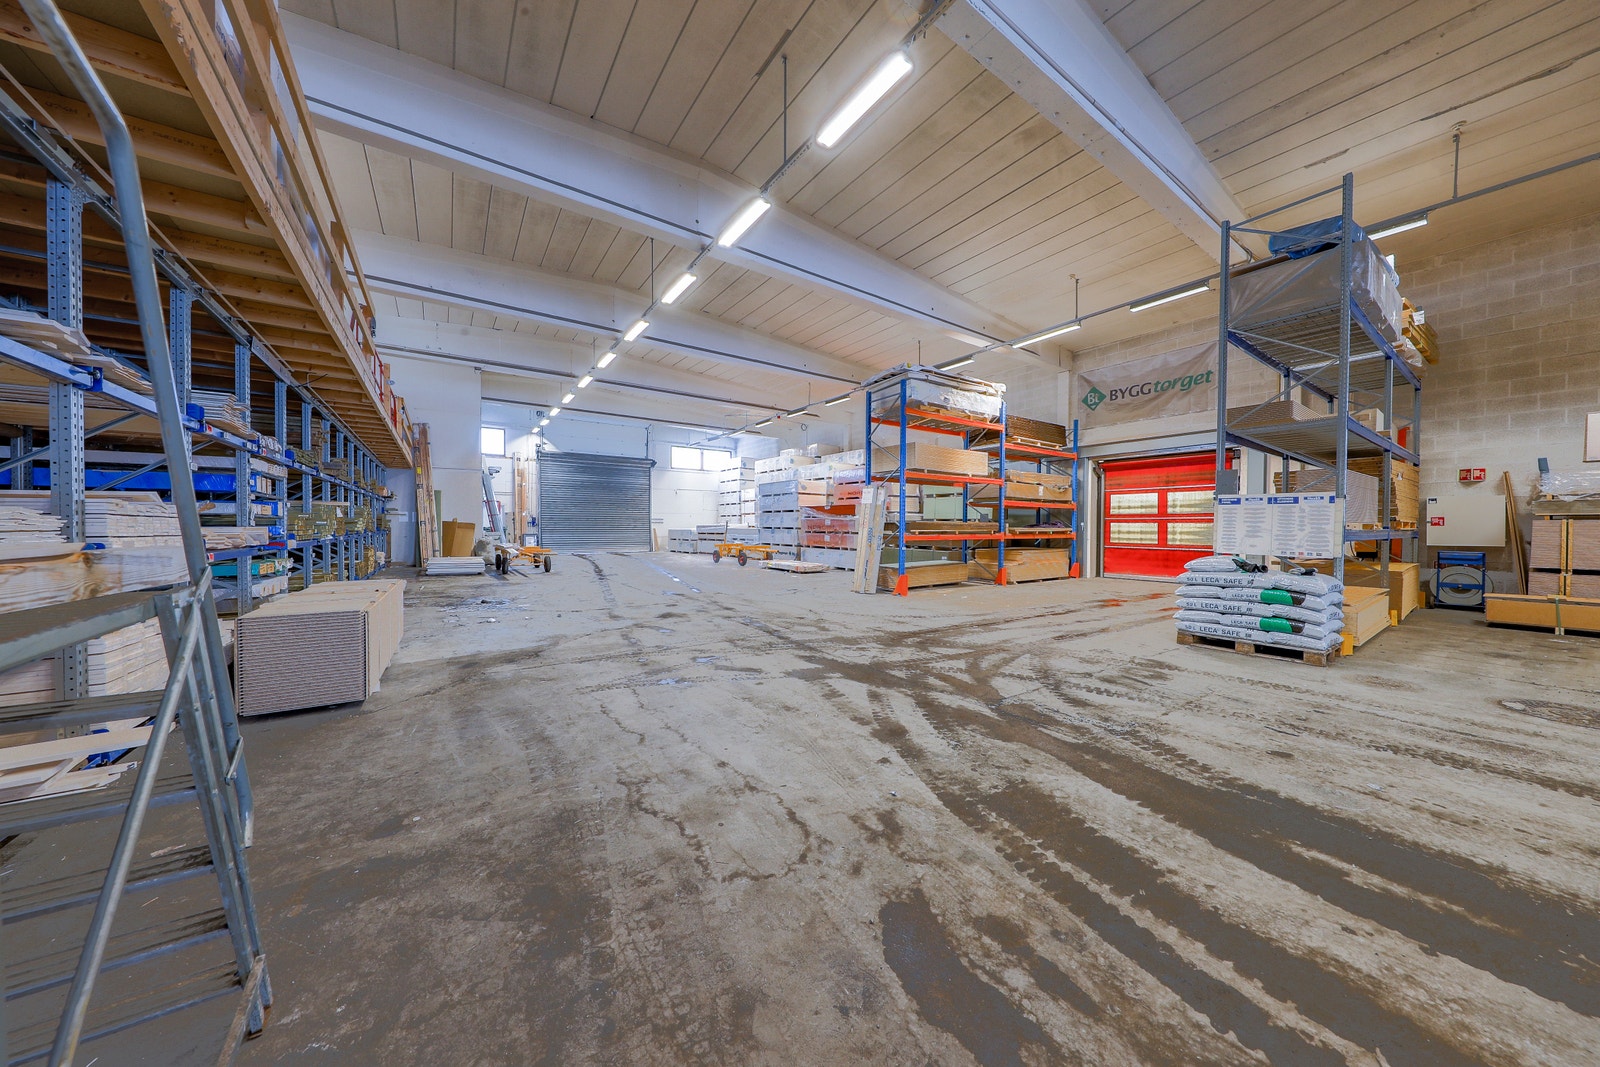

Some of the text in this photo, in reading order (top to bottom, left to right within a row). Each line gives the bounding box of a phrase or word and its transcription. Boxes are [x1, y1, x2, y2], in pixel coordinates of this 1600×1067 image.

[1109, 369, 1214, 401] BYGGtorget
[1222, 604, 1242, 612] SAFE
[1199, 625, 1218, 633] LECA
[1221, 629, 1241, 637] SAFE
